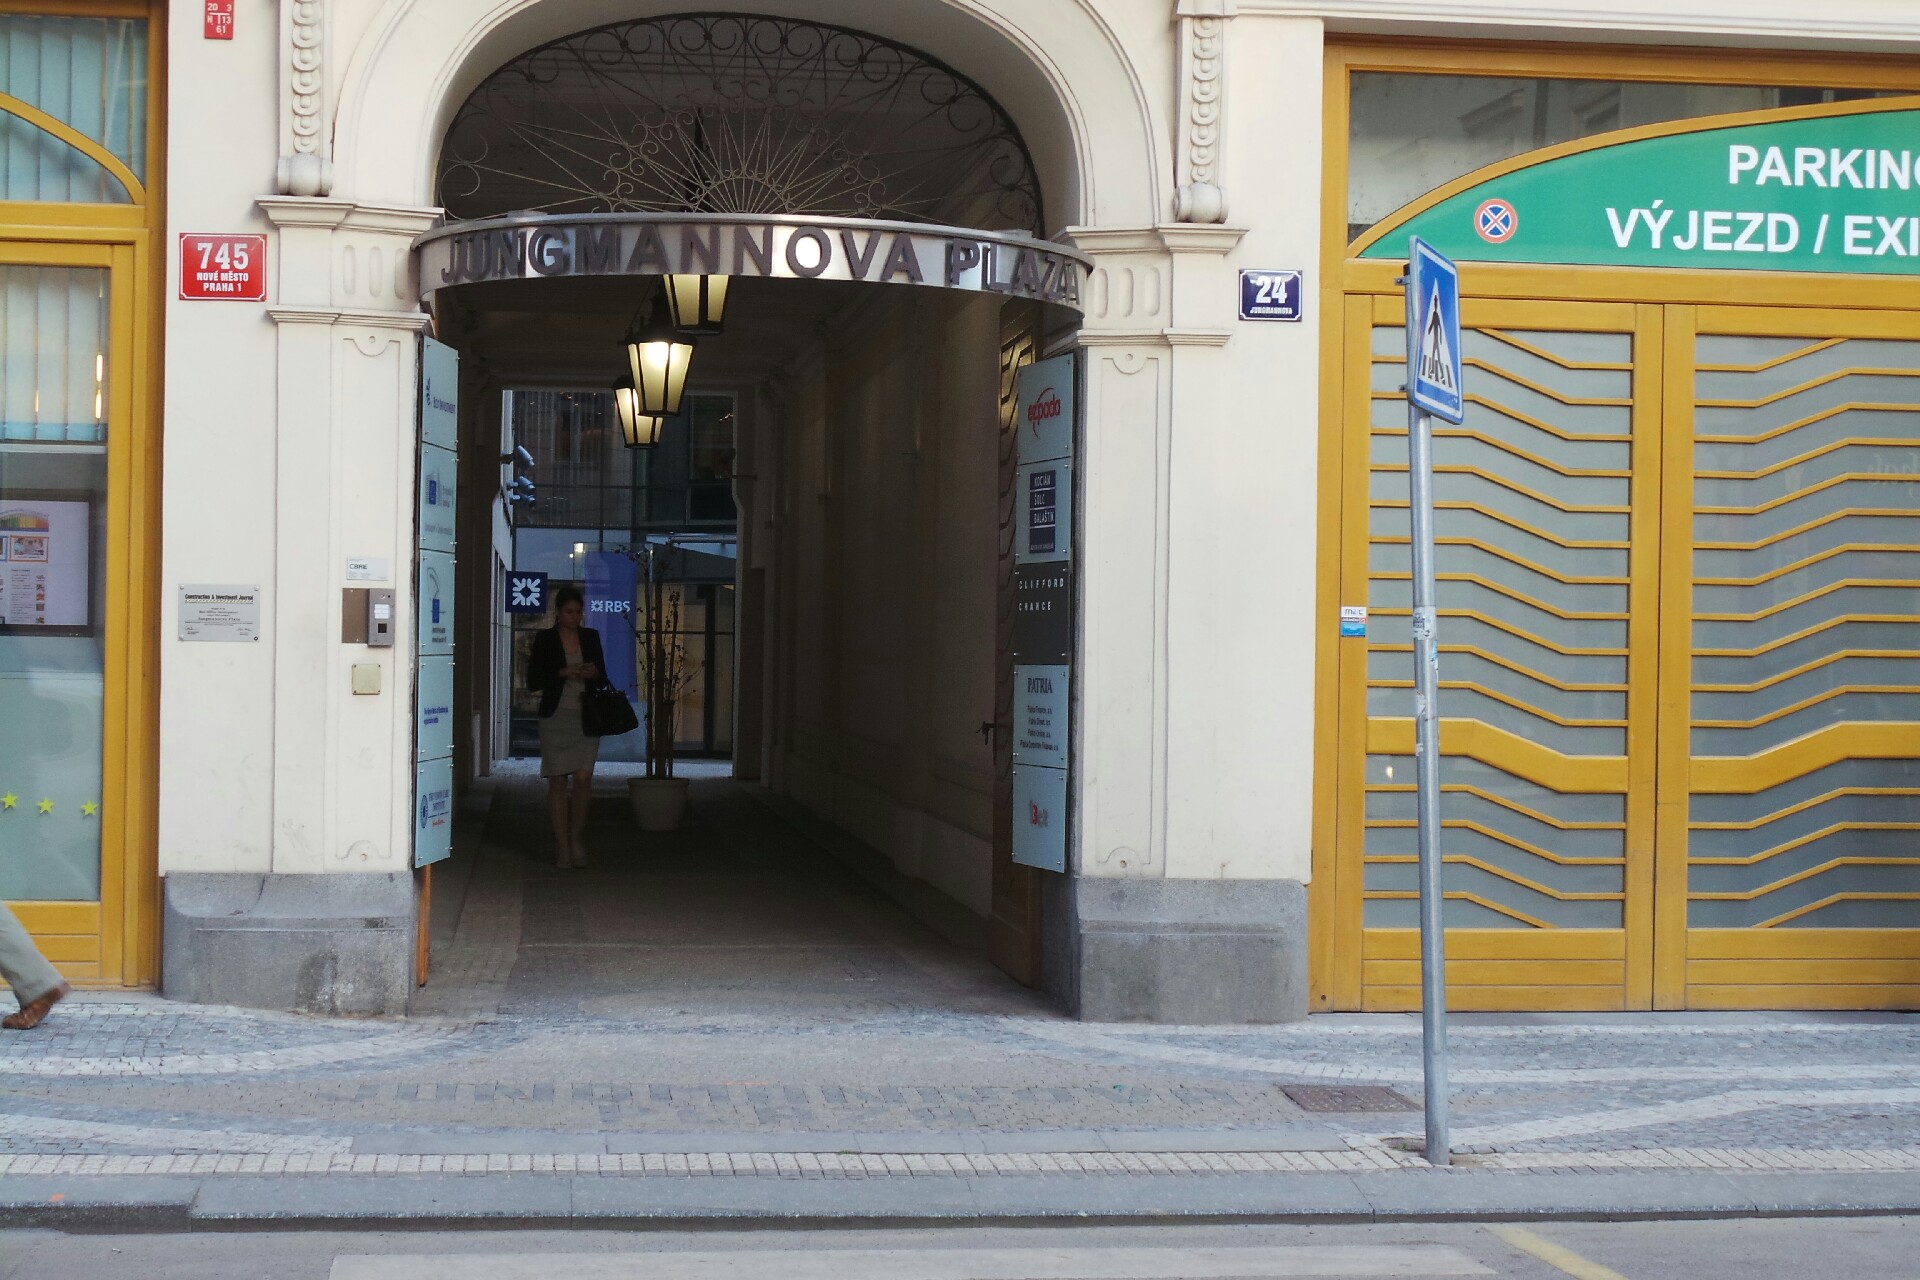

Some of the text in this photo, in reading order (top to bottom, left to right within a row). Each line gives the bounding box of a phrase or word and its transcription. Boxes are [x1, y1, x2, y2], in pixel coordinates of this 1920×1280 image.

[216, 25, 226, 34] 61
[1729, 144, 1920, 190] PARKIN
[1605, 199, 1799, 253] VÝJEZD
[1813, 213, 1830, 255] /
[197, 242, 249, 270] 745
[441, 222, 1081, 306] JUNGMANNOVA PLAZA
[196, 270, 249, 282] NOVÉ MĚSTO
[203, 282, 242, 292] PRAHA 1
[1255, 275, 1288, 304] 24
[1019, 578, 1064, 590] CLIFFORD
[605, 600, 631, 613] RBS
[1018, 601, 1051, 611] CHANCE
[1027, 677, 1053, 694] PATRIA
